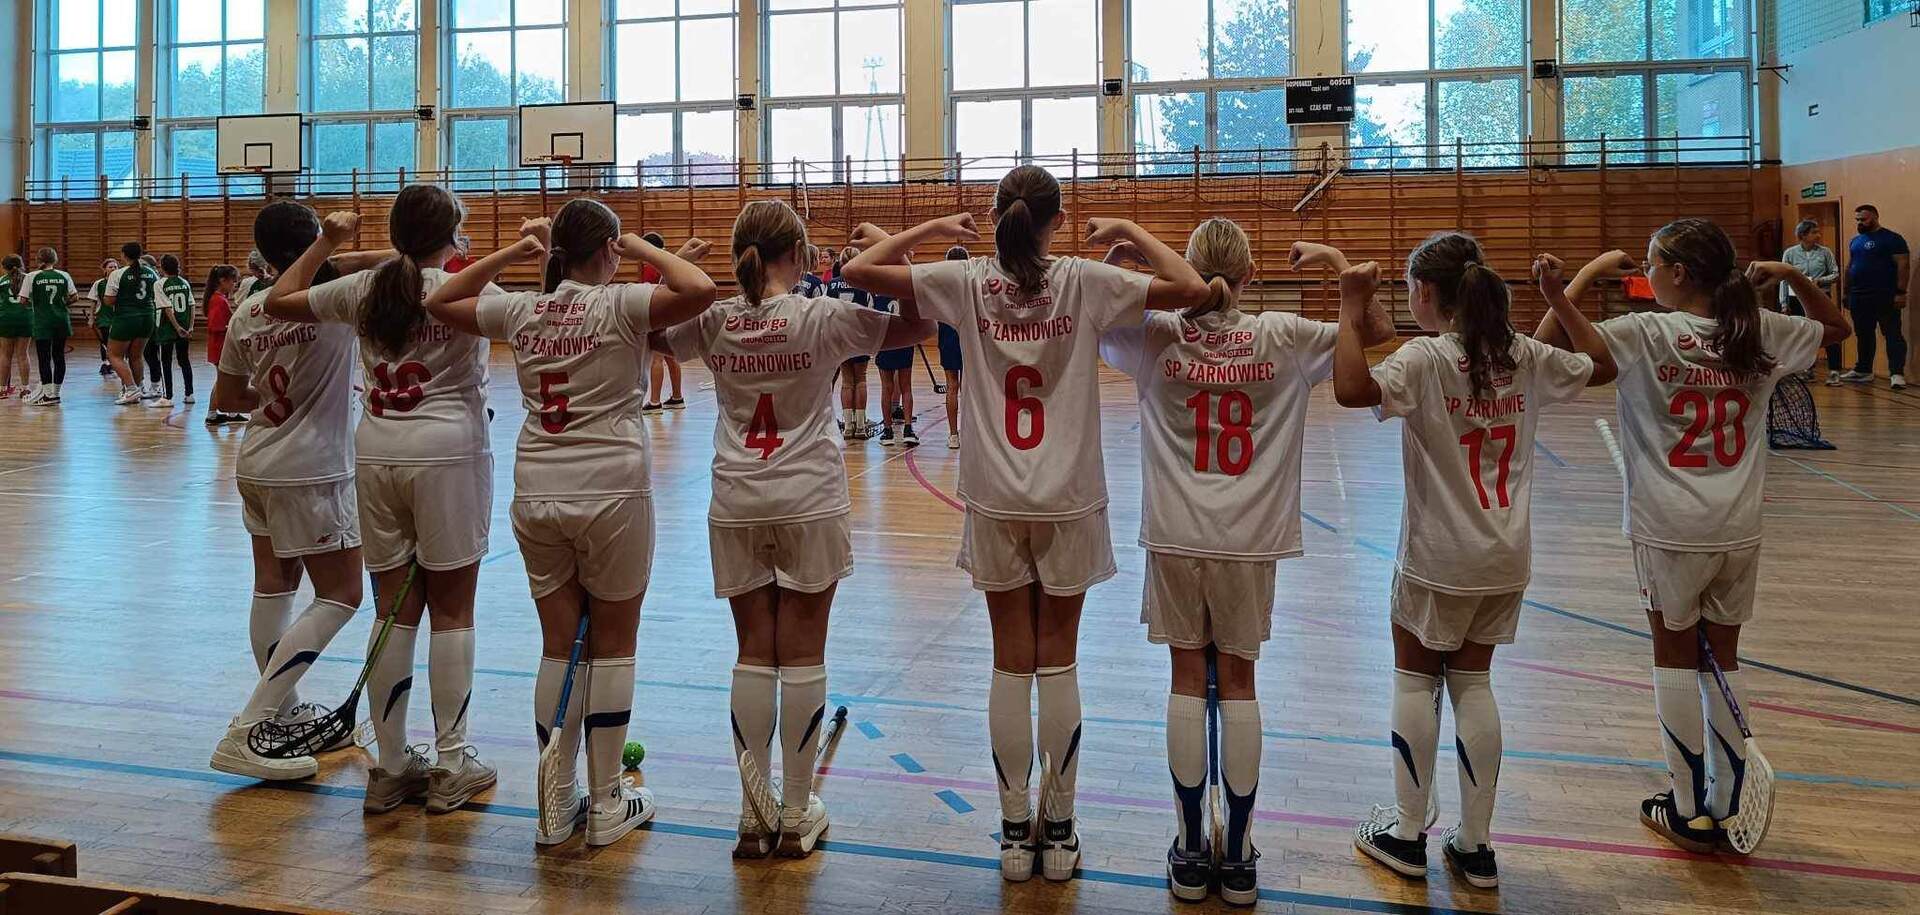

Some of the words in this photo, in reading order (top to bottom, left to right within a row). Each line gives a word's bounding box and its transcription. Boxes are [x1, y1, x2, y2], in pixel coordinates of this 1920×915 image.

[1329, 78, 1352, 86] GOŚCIE
[45, 285, 58, 305] 7
[135, 280, 147, 300] 3
[169, 292, 187, 313] 10
[742, 316, 788, 332] Energa
[993, 314, 1073, 342] ŻARNOWIEC
[514, 333, 529, 352] SP
[1205, 331, 1253, 345] Energa
[711, 353, 727, 373] SP
[730, 351, 812, 374] ŻARNOWIEC
[1165, 359, 1182, 379] SP
[1187, 360, 1275, 383] ŻARNOWIEC
[1657, 364, 1679, 384] SP
[263, 364, 294, 427] 8
[539, 371, 570, 435] 5
[1004, 364, 1045, 451] 6
[1465, 394, 1526, 420] ŻARNOWIE
[744, 392, 785, 461] 4
[1186, 389, 1255, 477] 18
[1667, 387, 1751, 468] 20
[1459, 423, 1517, 510] 17
